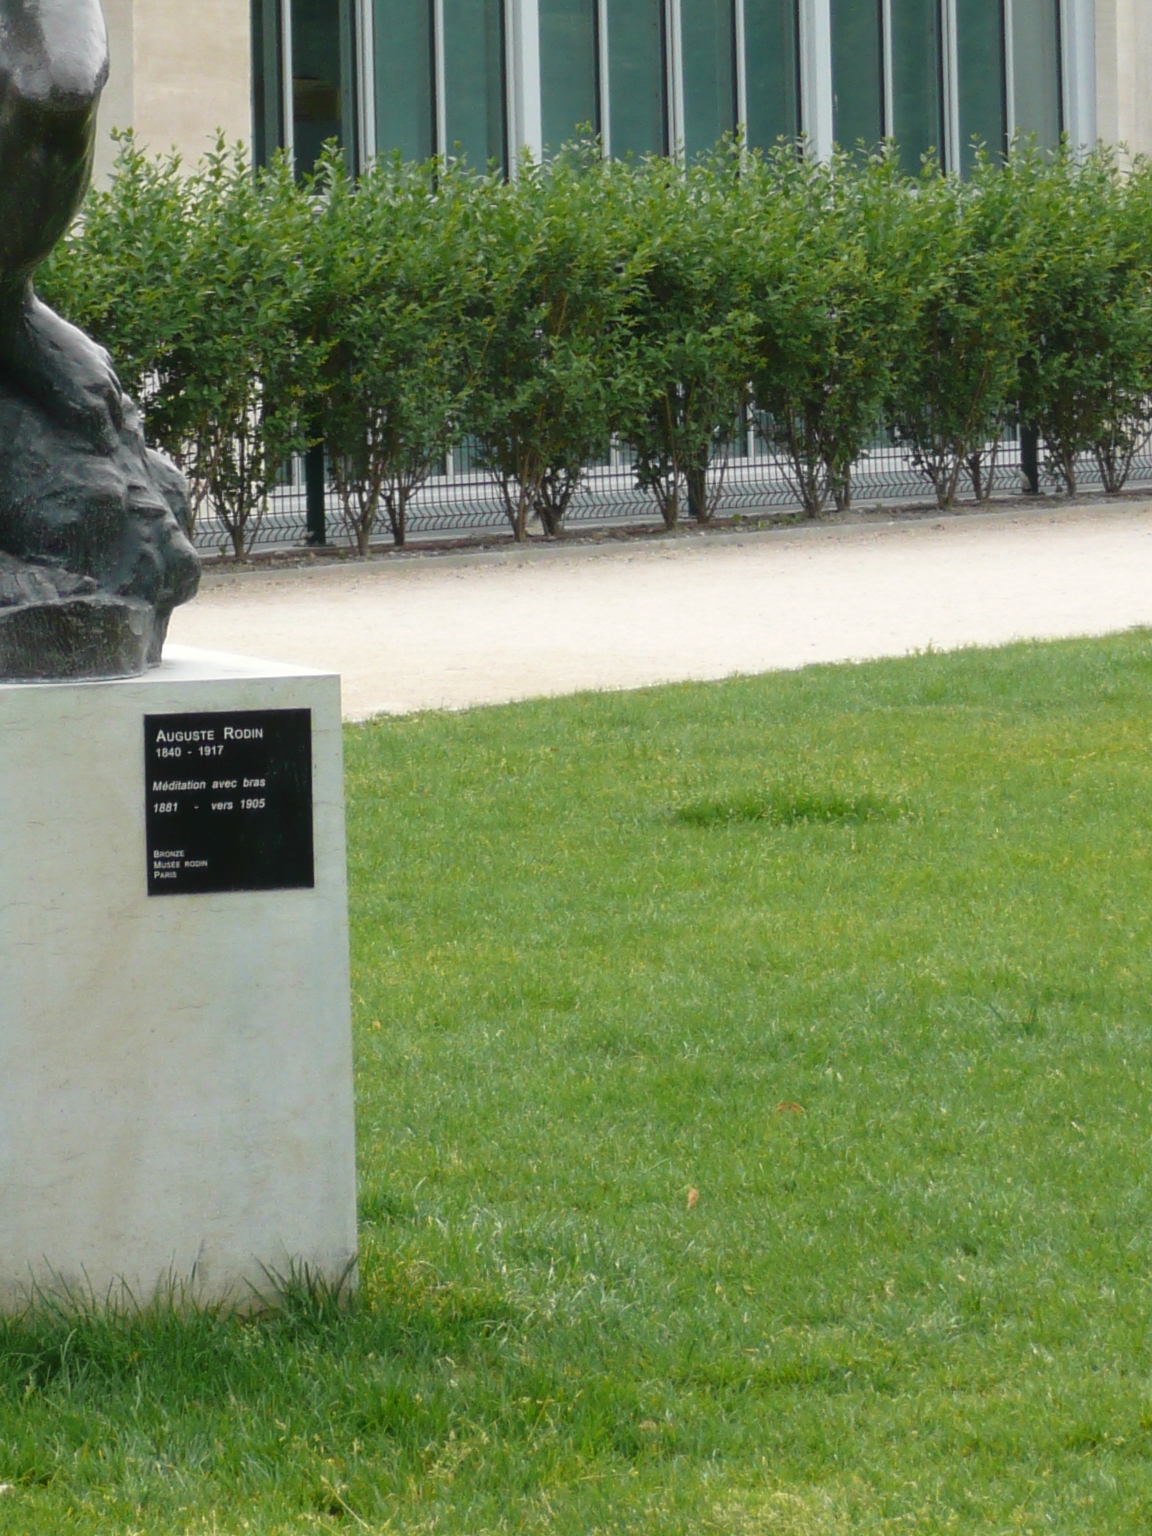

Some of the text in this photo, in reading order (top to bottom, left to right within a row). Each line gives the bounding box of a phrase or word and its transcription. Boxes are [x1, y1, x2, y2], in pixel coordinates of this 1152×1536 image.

[155, 726, 264, 743] AUGUSTE RODIN
[155, 746, 182, 758] 1840
[198, 744, 224, 756] 1917
[152, 777, 266, 791] Méditation avec bras
[152, 801, 179, 813] 1881
[211, 800, 234, 811] vers
[240, 798, 266, 810] 1905
[153, 849, 185, 859] BRONZE
[153, 870, 178, 879] PARIS
